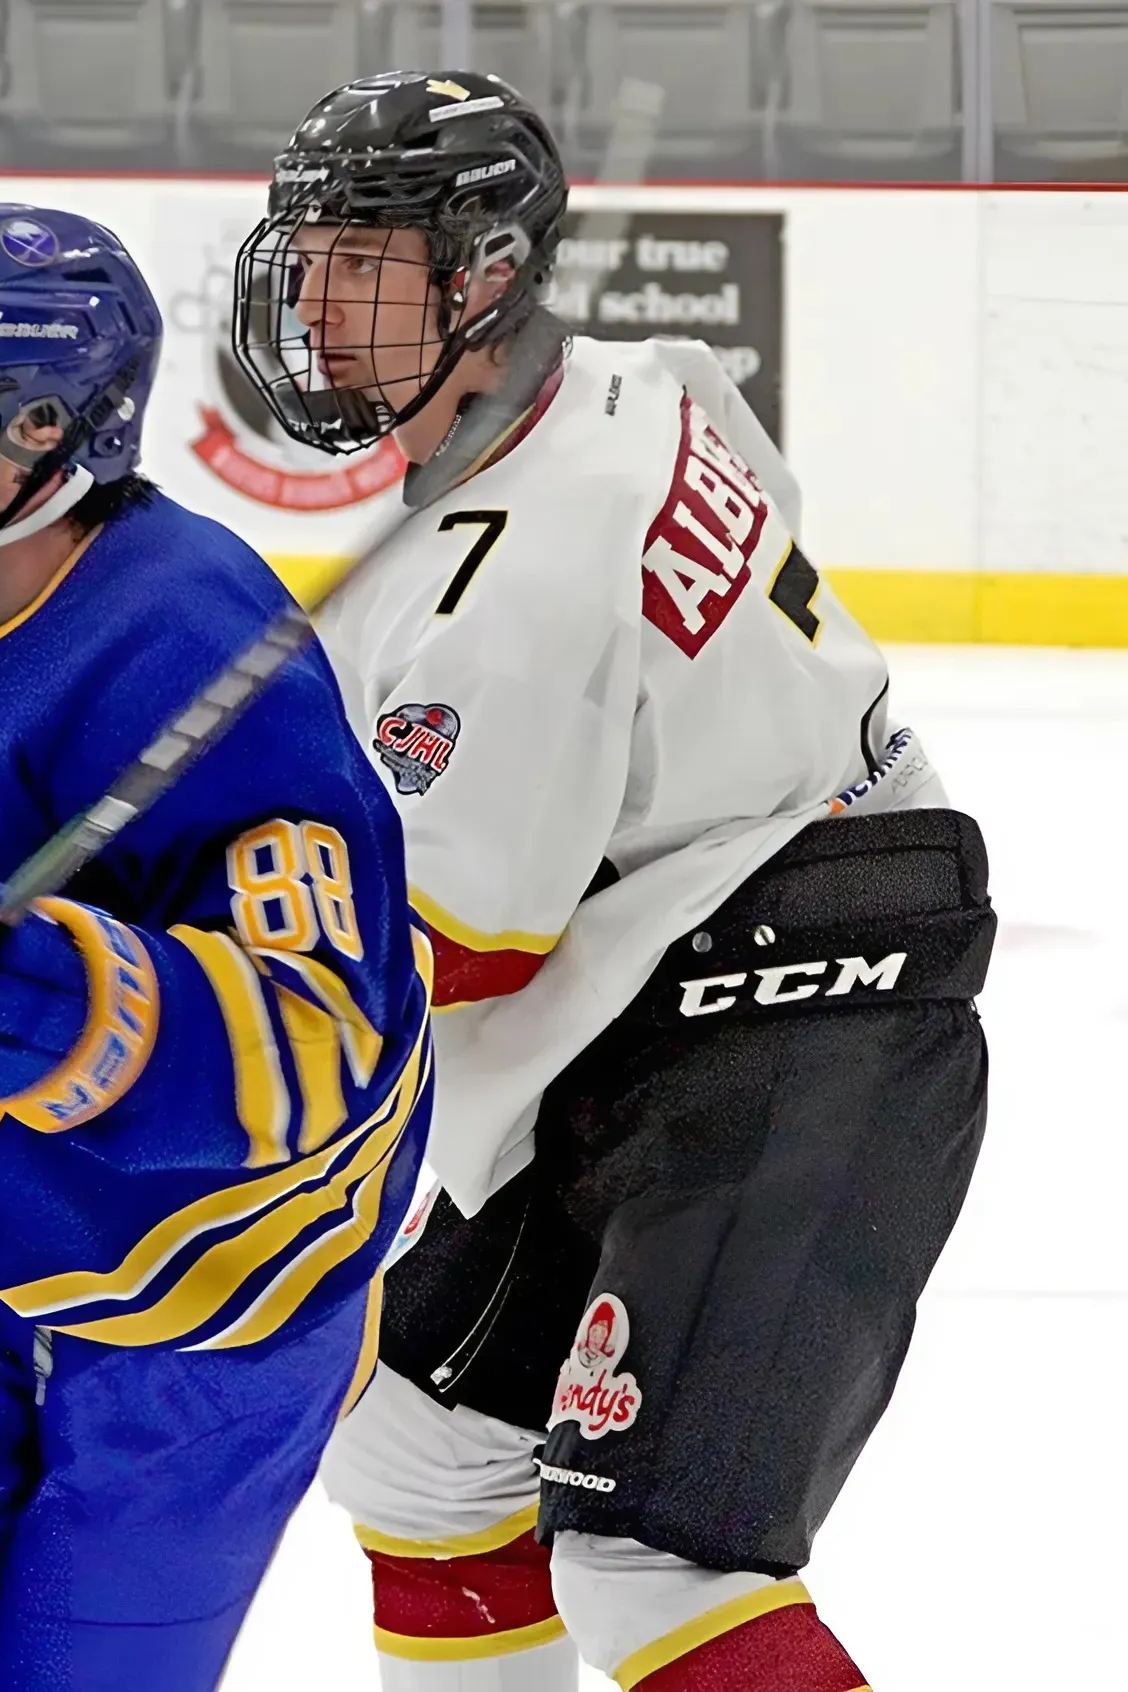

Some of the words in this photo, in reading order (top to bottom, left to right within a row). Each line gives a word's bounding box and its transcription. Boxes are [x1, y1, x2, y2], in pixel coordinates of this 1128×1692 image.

[636, 235, 729, 272] true
[599, 282, 740, 326] school
[435, 510, 509, 618] 7
[379, 716, 453, 773] CJHL
[226, 818, 364, 962] 88
[679, 952, 908, 1017] CCM
